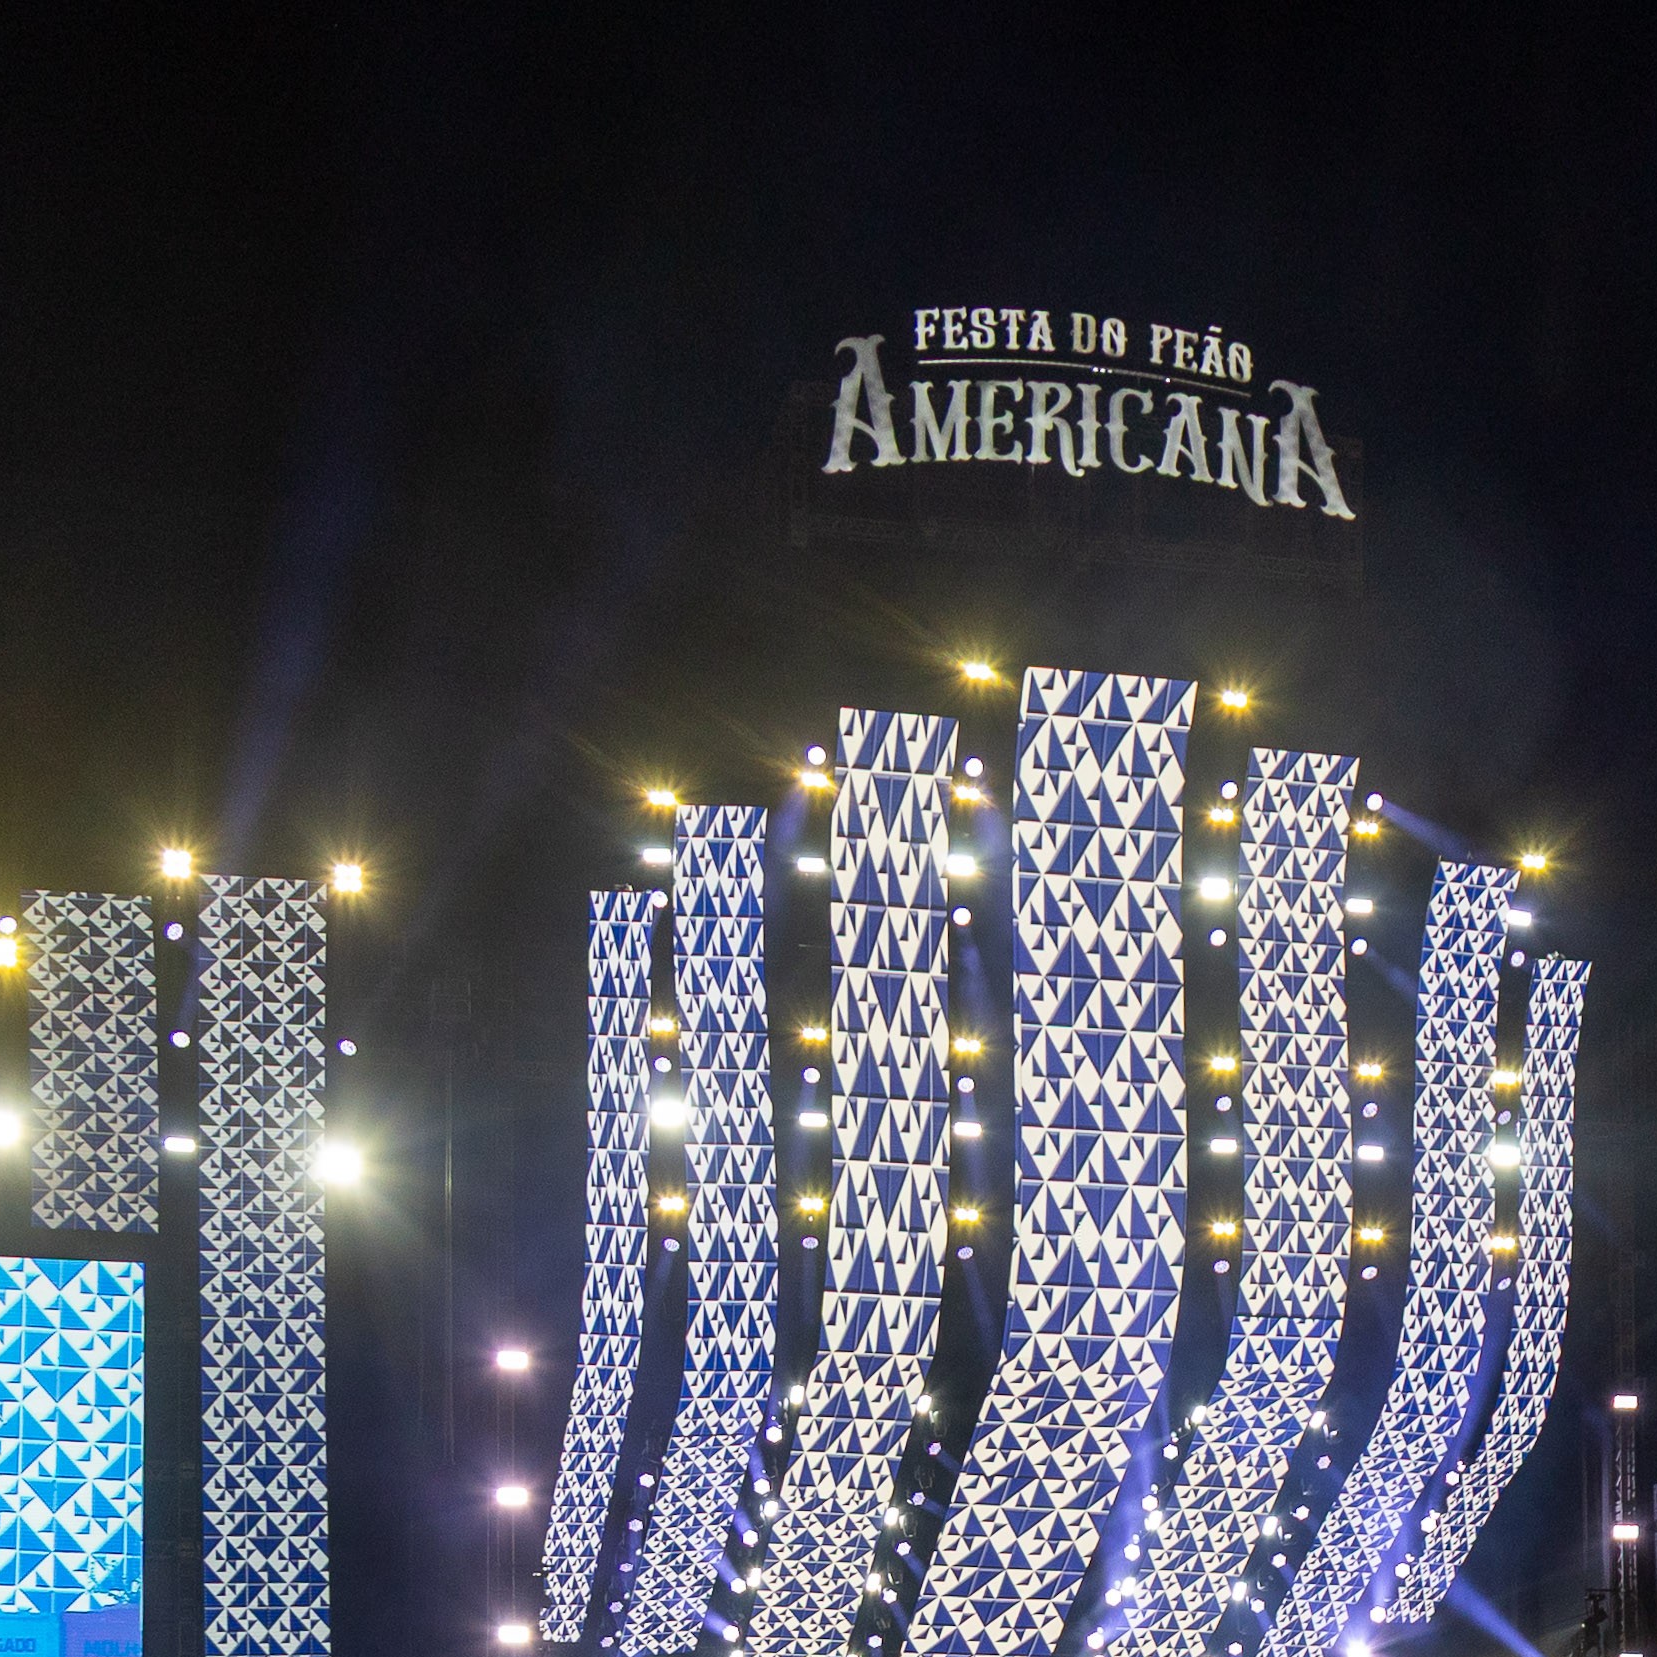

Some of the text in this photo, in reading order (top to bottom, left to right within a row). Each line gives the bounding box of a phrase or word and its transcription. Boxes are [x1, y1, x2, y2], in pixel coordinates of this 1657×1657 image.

[913, 306, 1254, 384] FESTA DO PEÃO
[821, 332, 1357, 521] AMERICANA
